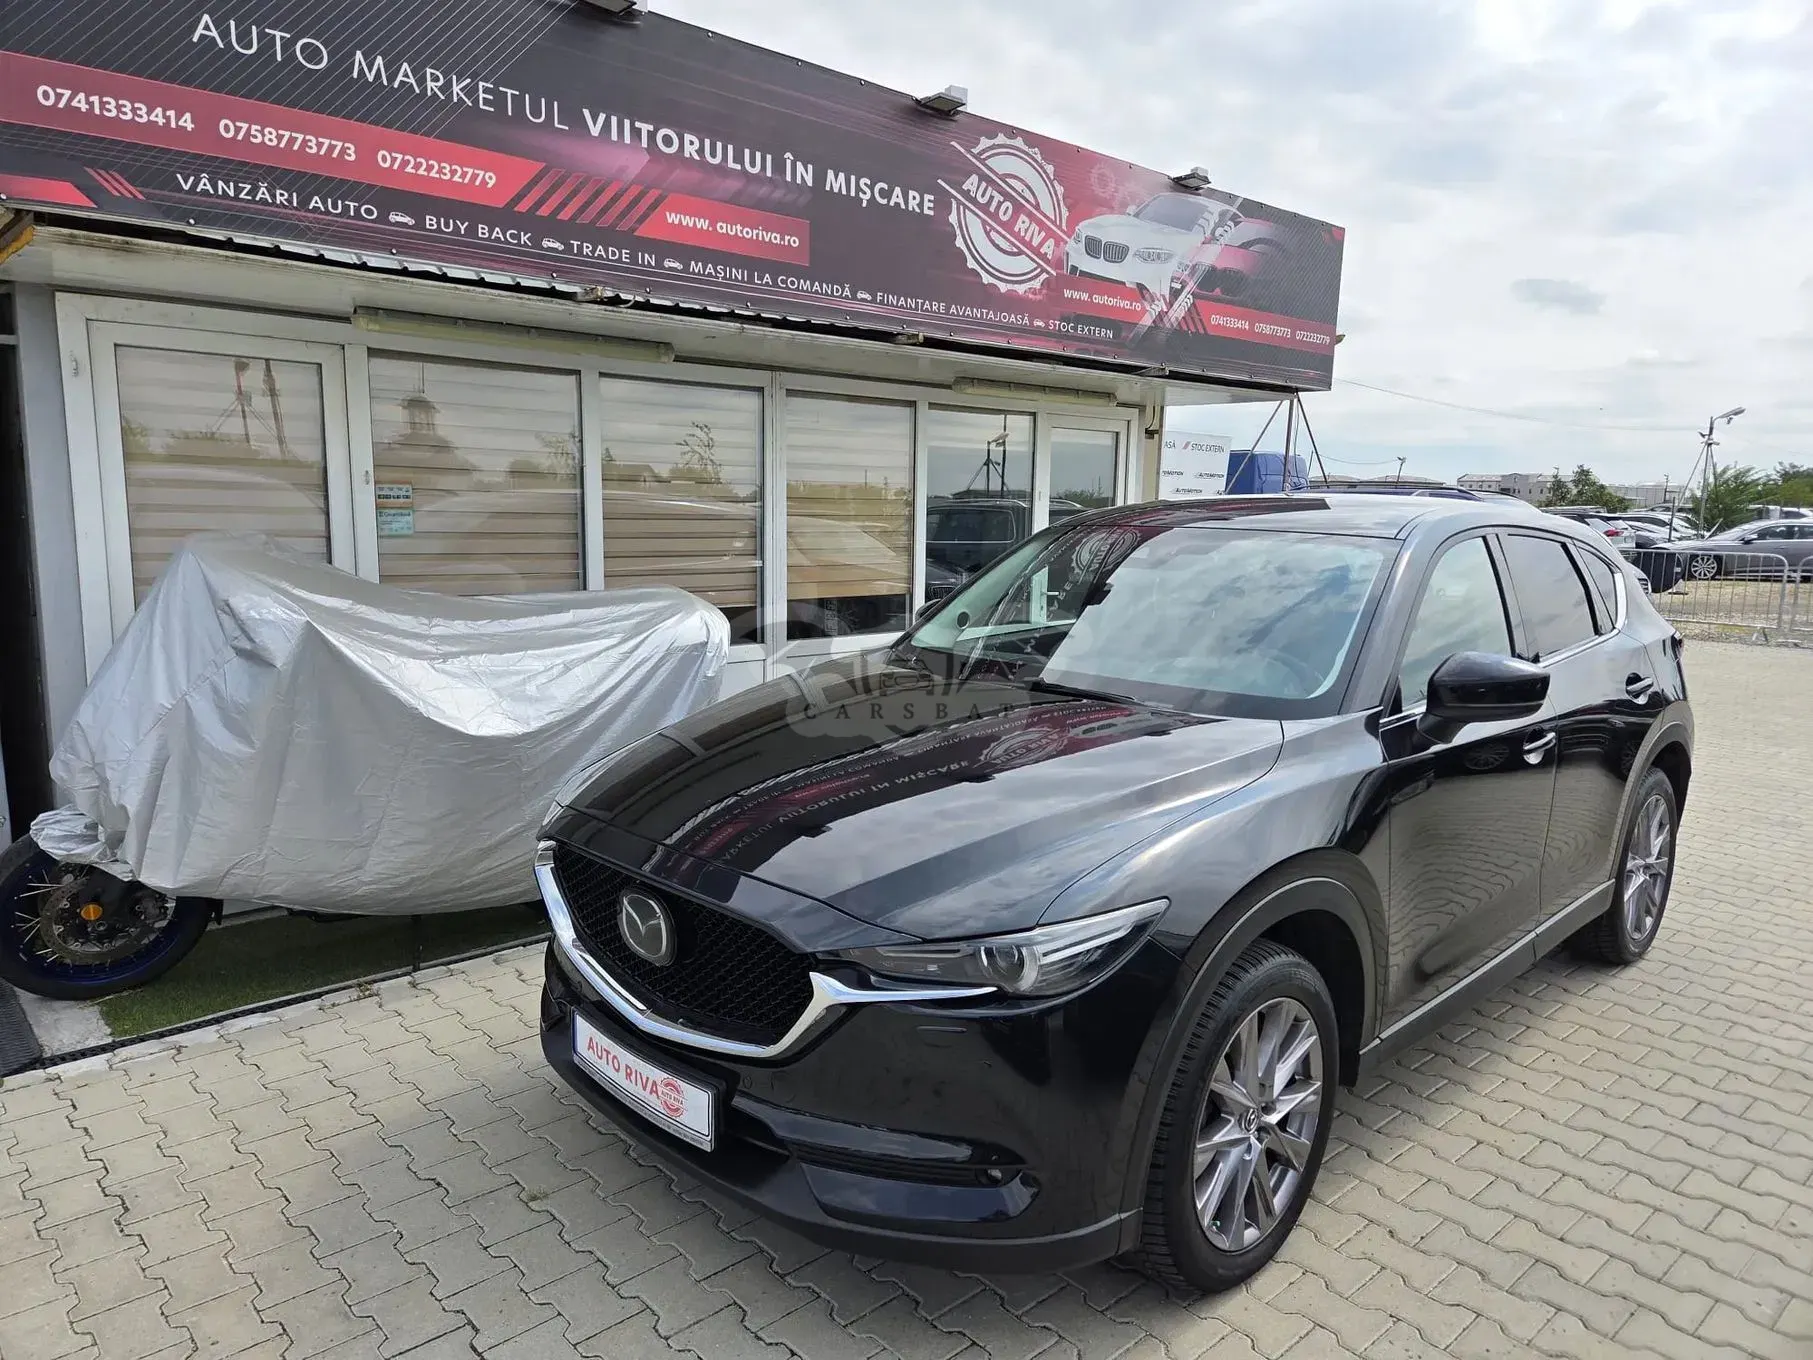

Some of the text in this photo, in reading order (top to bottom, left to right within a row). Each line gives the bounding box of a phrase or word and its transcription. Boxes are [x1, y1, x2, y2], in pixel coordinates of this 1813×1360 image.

[36, 84, 497, 189] 0741333414 0758773773 0722232779
[193, 13, 935, 217] AUTO MARKETUL VIITORULUI ÎN MIȘCARE
[176, 172, 1113, 339] VÂNZĂRI AUTO BUY BACK TRADE IN MAȘINI LA COMANDĂ FINANȚARE AVANTAJOASĂ STOC EXTERN
[962, 173, 1057, 260] AUTO RIVA
[1210, 314, 1249, 331] 0741333414
[587, 1036, 621, 1073] AUTO
[625, 1064, 660, 1100] RIVA
